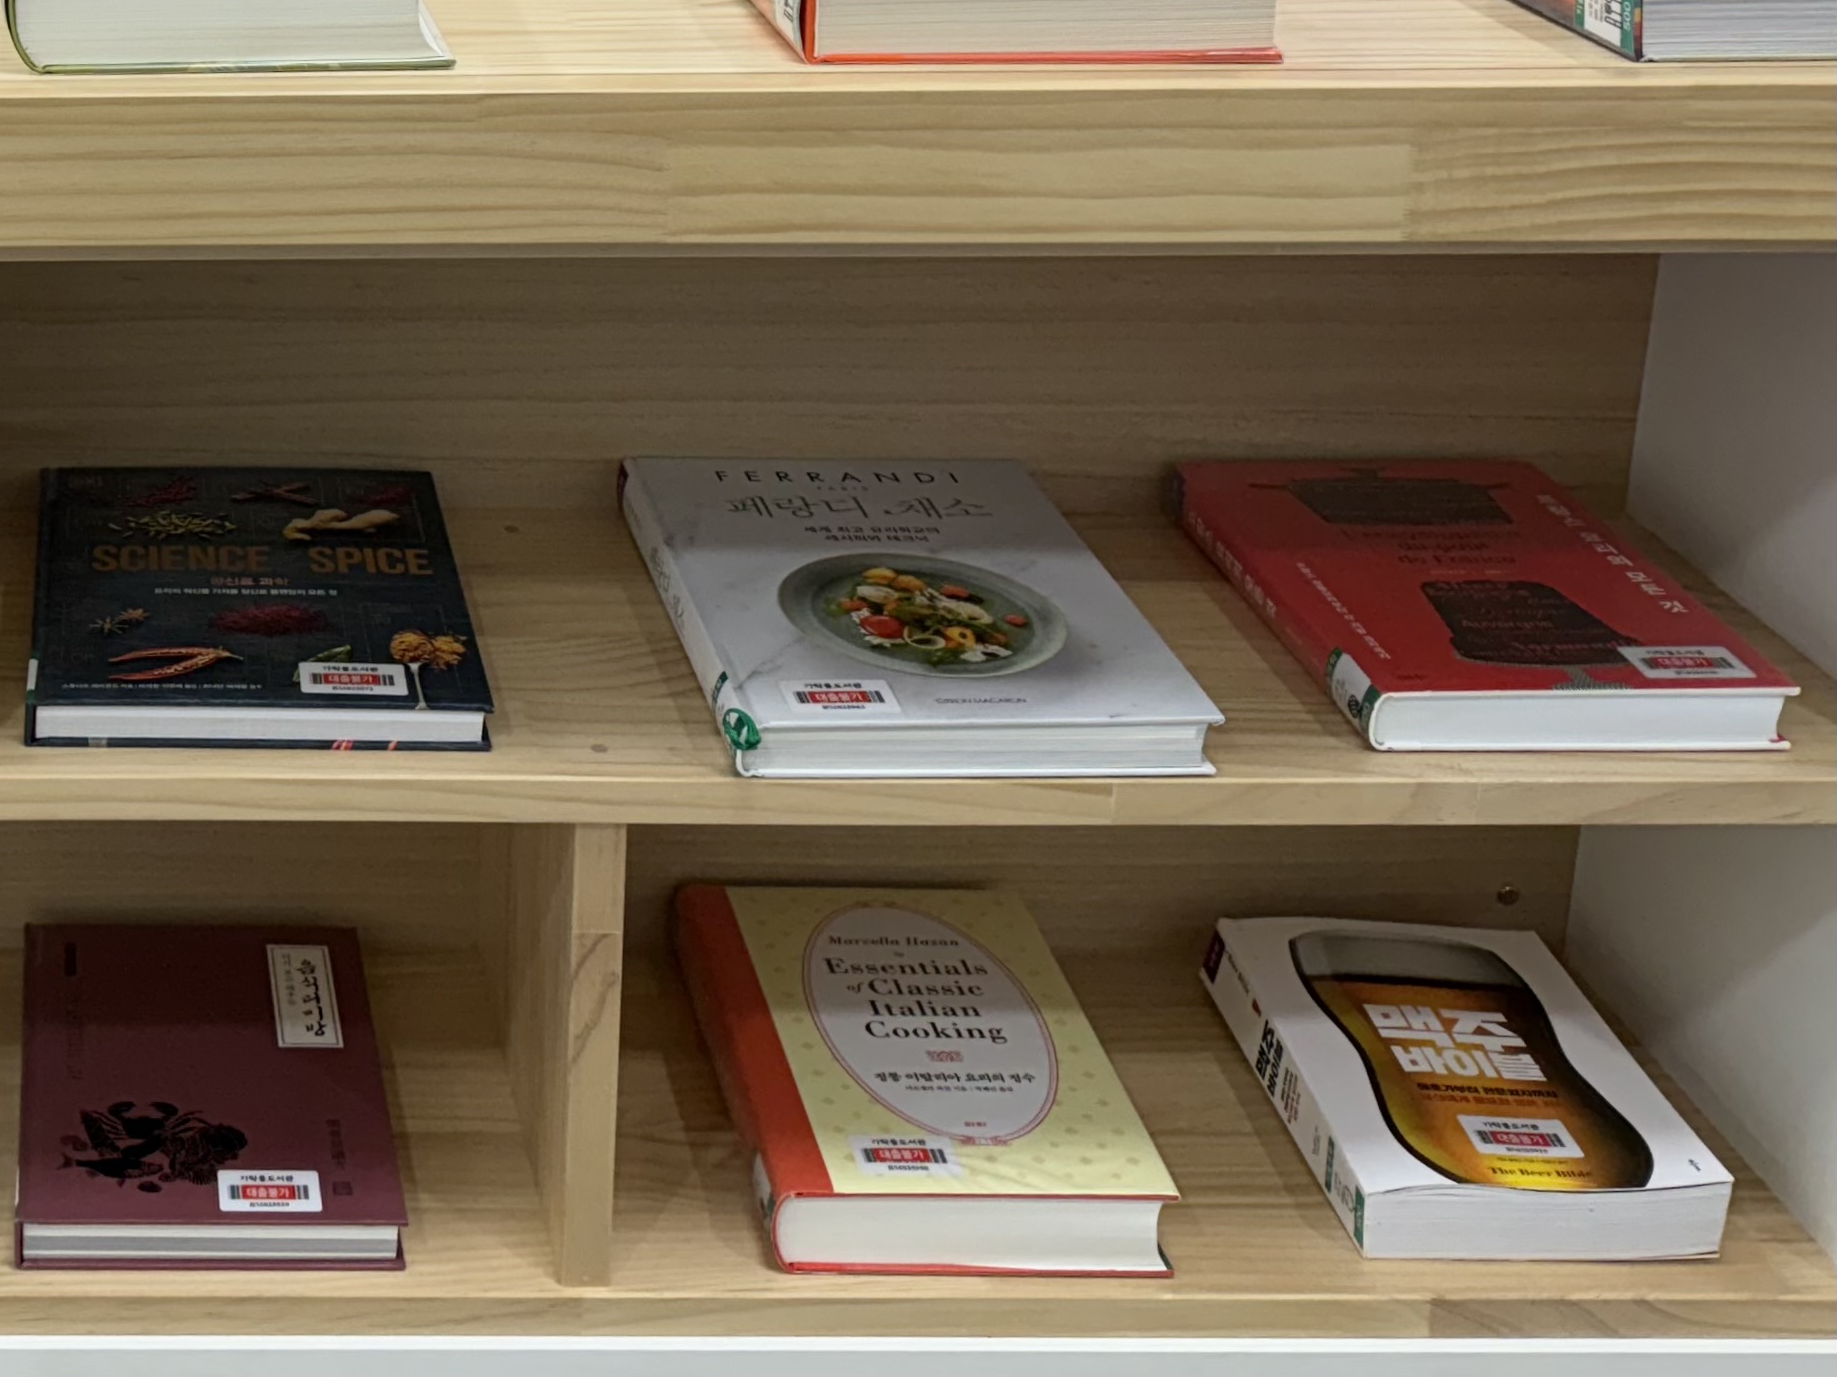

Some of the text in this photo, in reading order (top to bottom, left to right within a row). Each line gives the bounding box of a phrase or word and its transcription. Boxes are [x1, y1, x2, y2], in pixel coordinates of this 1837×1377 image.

[715, 470, 960, 484] FERRANDI
[728, 496, 993, 520] 페랑디 채소
[92, 545, 434, 575] SCIENCE SPICE
[259, 576, 291, 586] 과학
[1627, 569, 1689, 614] 모든 것
[328, 675, 374, 685] 대출불가
[815, 692, 862, 703] 대출불가
[828, 936, 959, 947] Marcella Hazan
[823, 957, 988, 976] Essentials
[847, 979, 984, 997] of Classic
[868, 1000, 981, 1018] Italian
[864, 1021, 1008, 1045] Cooking
[1363, 1004, 1527, 1052] 맥주
[1390, 1044, 1548, 1082] 바이블
[905, 1073, 1036, 1084] 이탈리아 요리의 정수
[1496, 1133, 1544, 1145] 대출불가
[879, 1150, 924, 1162] 대출불가
[246, 1188, 290, 1198] 대출불가
